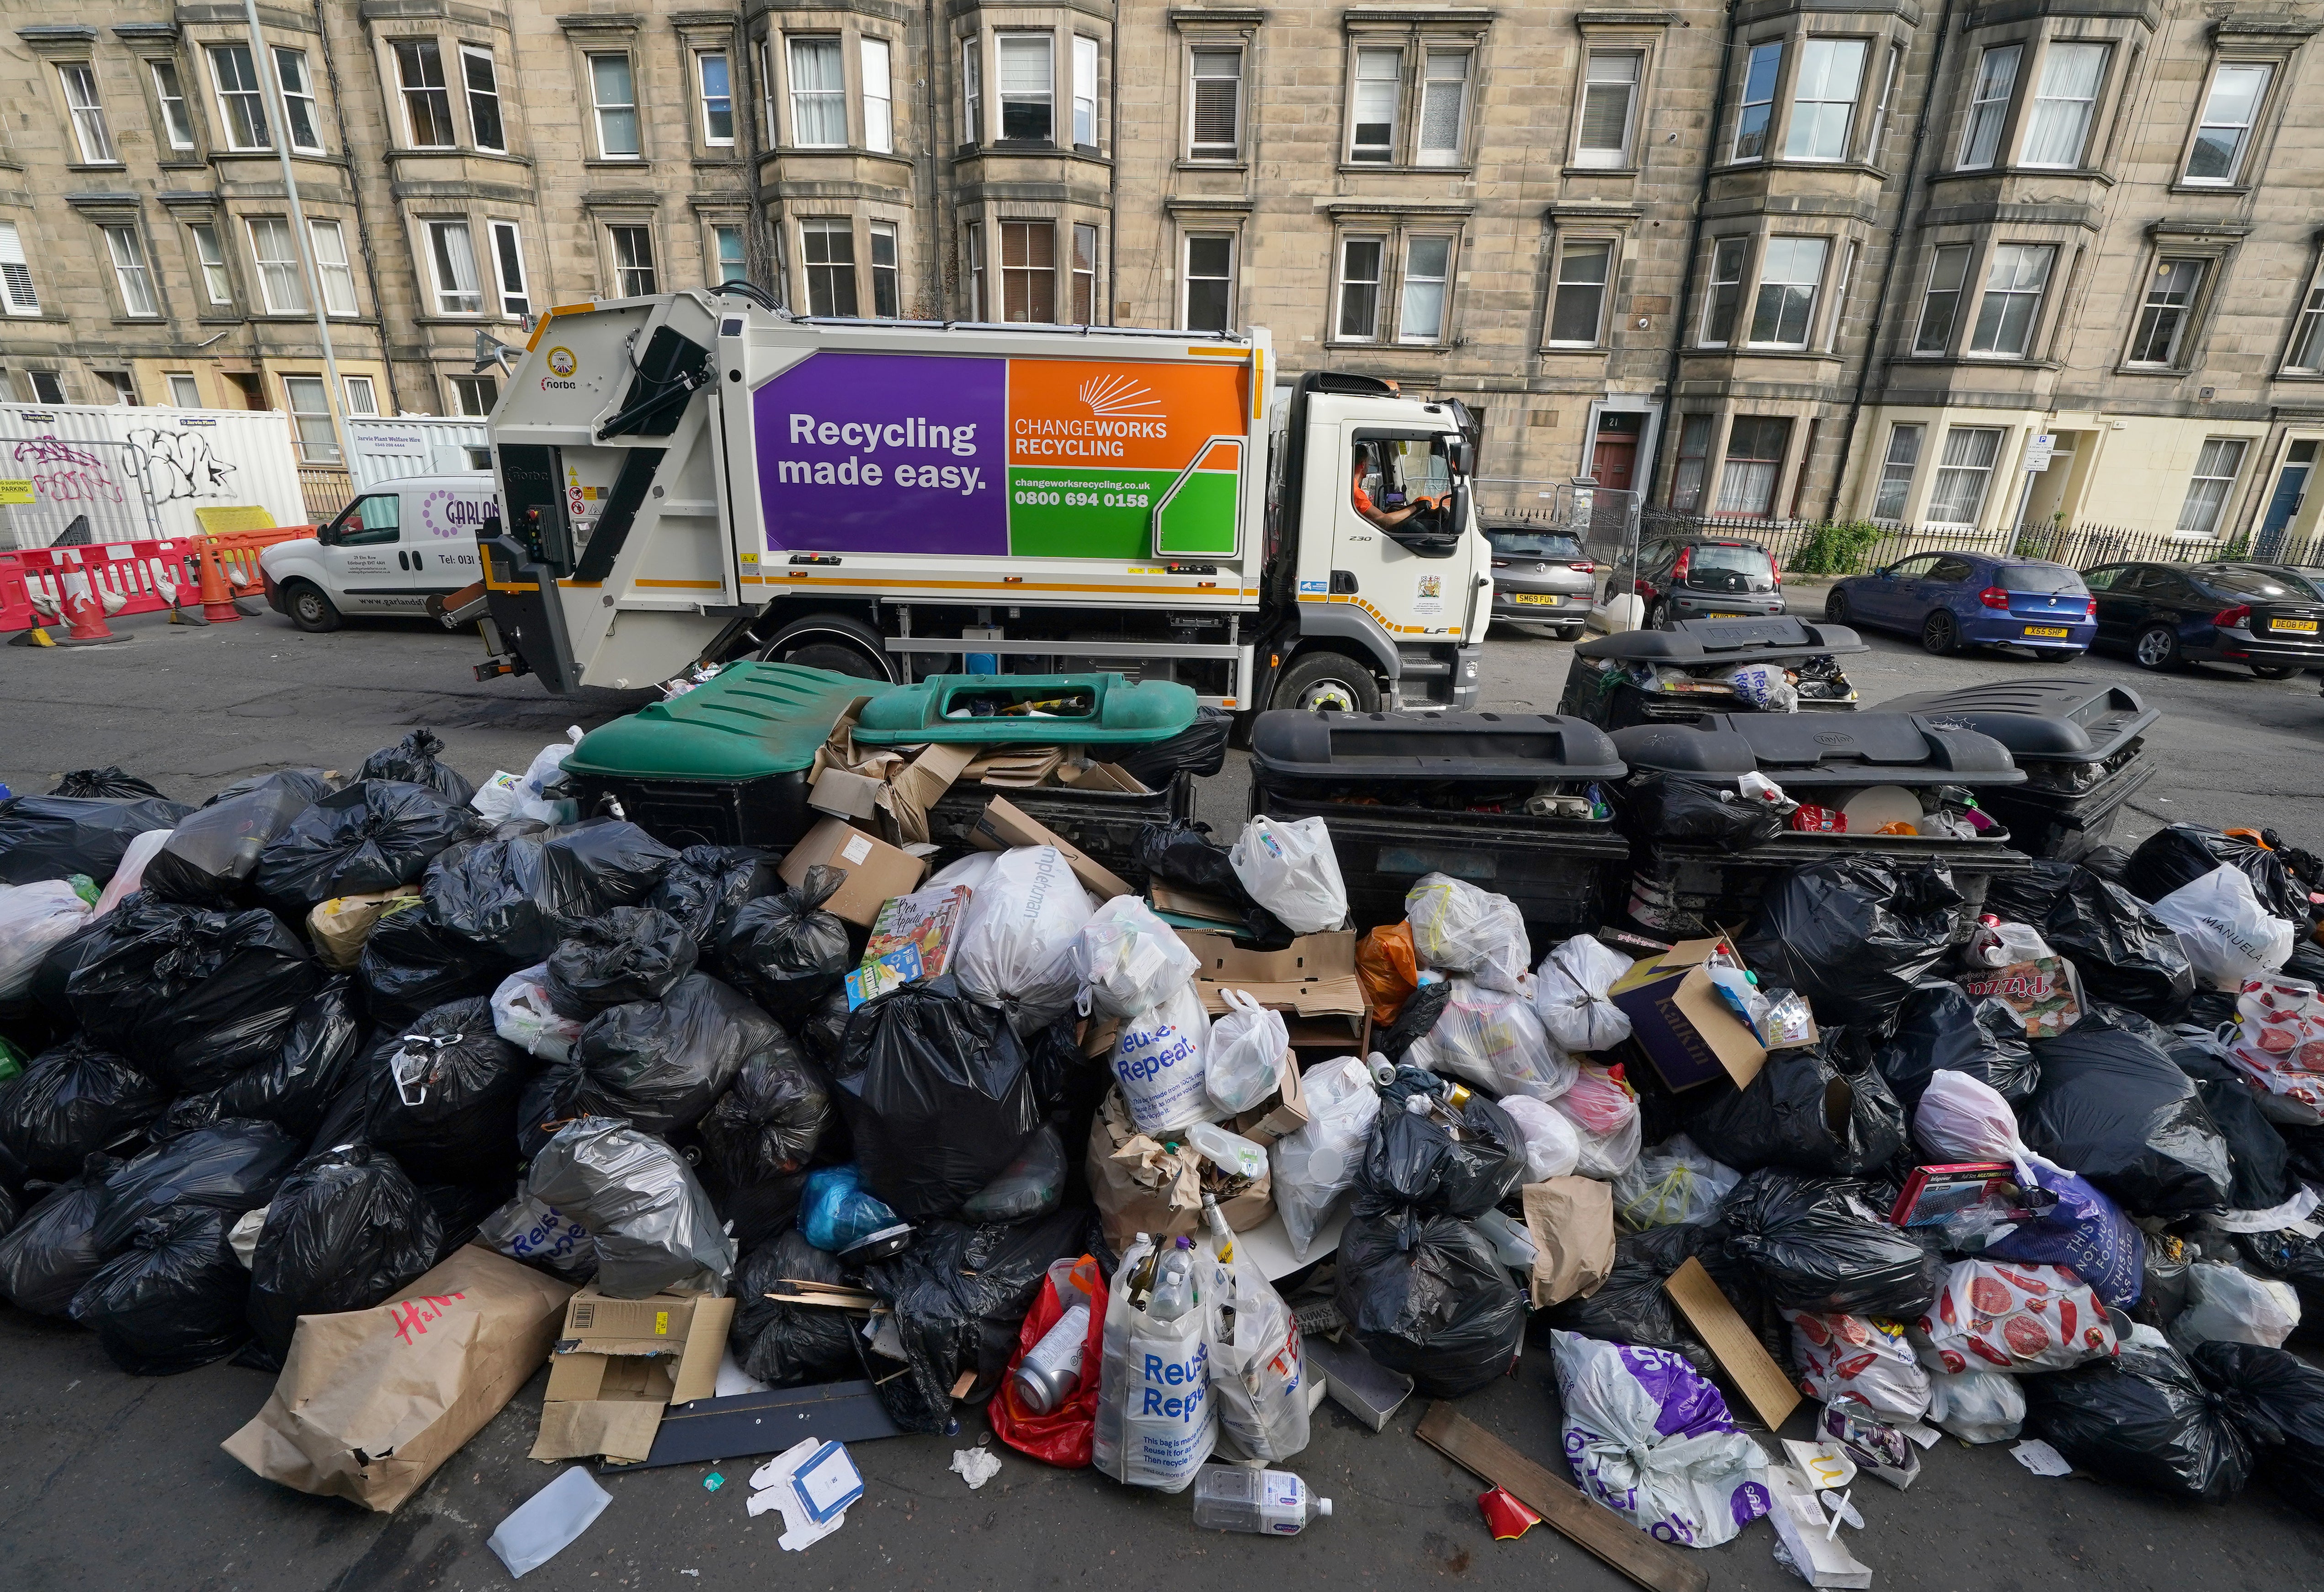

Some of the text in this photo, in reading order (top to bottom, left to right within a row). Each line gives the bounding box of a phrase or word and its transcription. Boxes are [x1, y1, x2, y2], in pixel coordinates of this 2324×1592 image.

[547, 380, 575, 389] norba
[1015, 419, 1167, 439] CHANGEWORKS
[1609, 418, 1618, 427] 21
[790, 413, 977, 456] Recycling
[1016, 438, 1124, 456] RECYCLING
[778, 456, 986, 496] made easy.
[1015, 478, 1150, 490] changeworksrecycling.co.uk
[1015, 491, 1149, 508] 0800 694 0158
[438, 555, 455, 564] Tel:
[458, 555, 474, 564] 0131
[1820, 734, 1851, 745] Taylor
[897, 899, 917, 914] Bon
[891, 913, 923, 933] Appetit
[2202, 917, 2263, 963] MANUELA
[1967, 976, 2050, 998] Pizza
[1118, 1035, 1196, 1084] Repeat.
[1165, 1095, 1176, 1105] long
[1182, 1087, 1192, 1098] you
[1192, 1081, 1203, 1091] can.
[2066, 1222, 2094, 1253] THIS
[2075, 1205, 2107, 1272] NOT JUST
[2095, 1228, 2113, 1269] FOOD
[2111, 1237, 2126, 1287] THIS IS
[2111, 1279, 2131, 1306] M&S
[1300, 1308, 1333, 1323] VOWS:
[1143, 1436, 1158, 1446] This
[1159, 1438, 1172, 1449] bag
[1181, 1433, 1197, 1446] made
[1143, 1445, 1165, 1456] Reuse
[1173, 1448, 1184, 1457] for
[1185, 1446, 1191, 1454] as
[1144, 1454, 1161, 1465] Then
[1163, 1454, 1188, 1468] recycle
[1165, 1470, 1180, 1478] more
